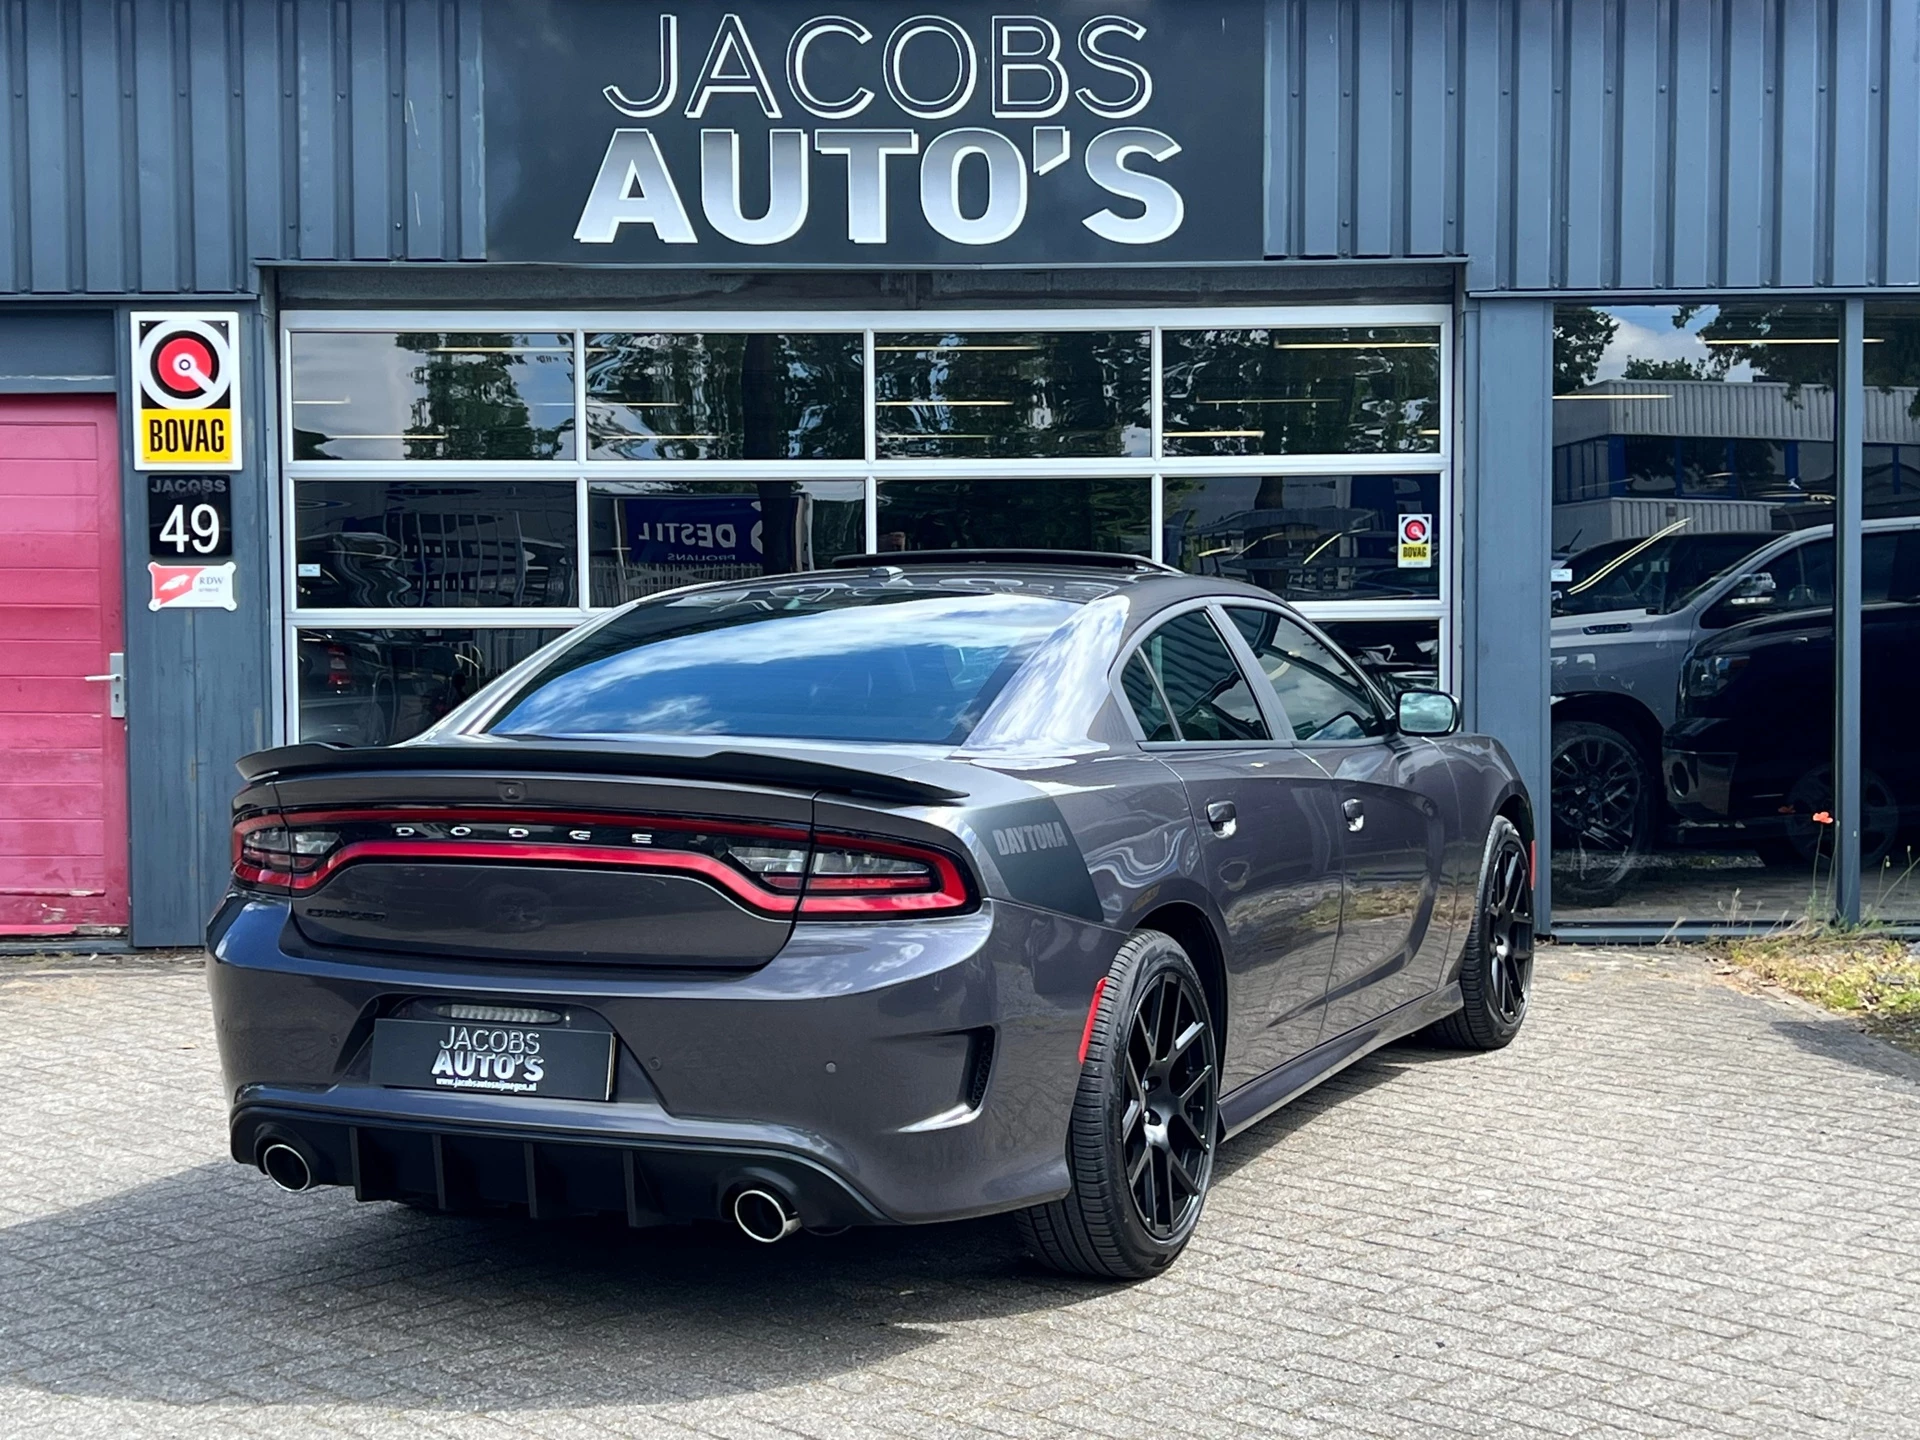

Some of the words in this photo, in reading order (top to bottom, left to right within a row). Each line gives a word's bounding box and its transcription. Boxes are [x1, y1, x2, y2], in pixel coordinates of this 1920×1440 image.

[602, 14, 1153, 119] JACOBS
[573, 125, 1185, 244] AUTO'S
[149, 418, 225, 453] BOVAG
[150, 479, 227, 493] JACOBS
[159, 503, 220, 554] 49
[1402, 546, 1427, 558] BOVAG
[199, 576, 224, 585] RDW
[395, 826, 653, 845] DODGE
[992, 821, 1069, 856] DAYTONA
[438, 1026, 541, 1054] JACOBS
[431, 1050, 545, 1082] AUTO'S
